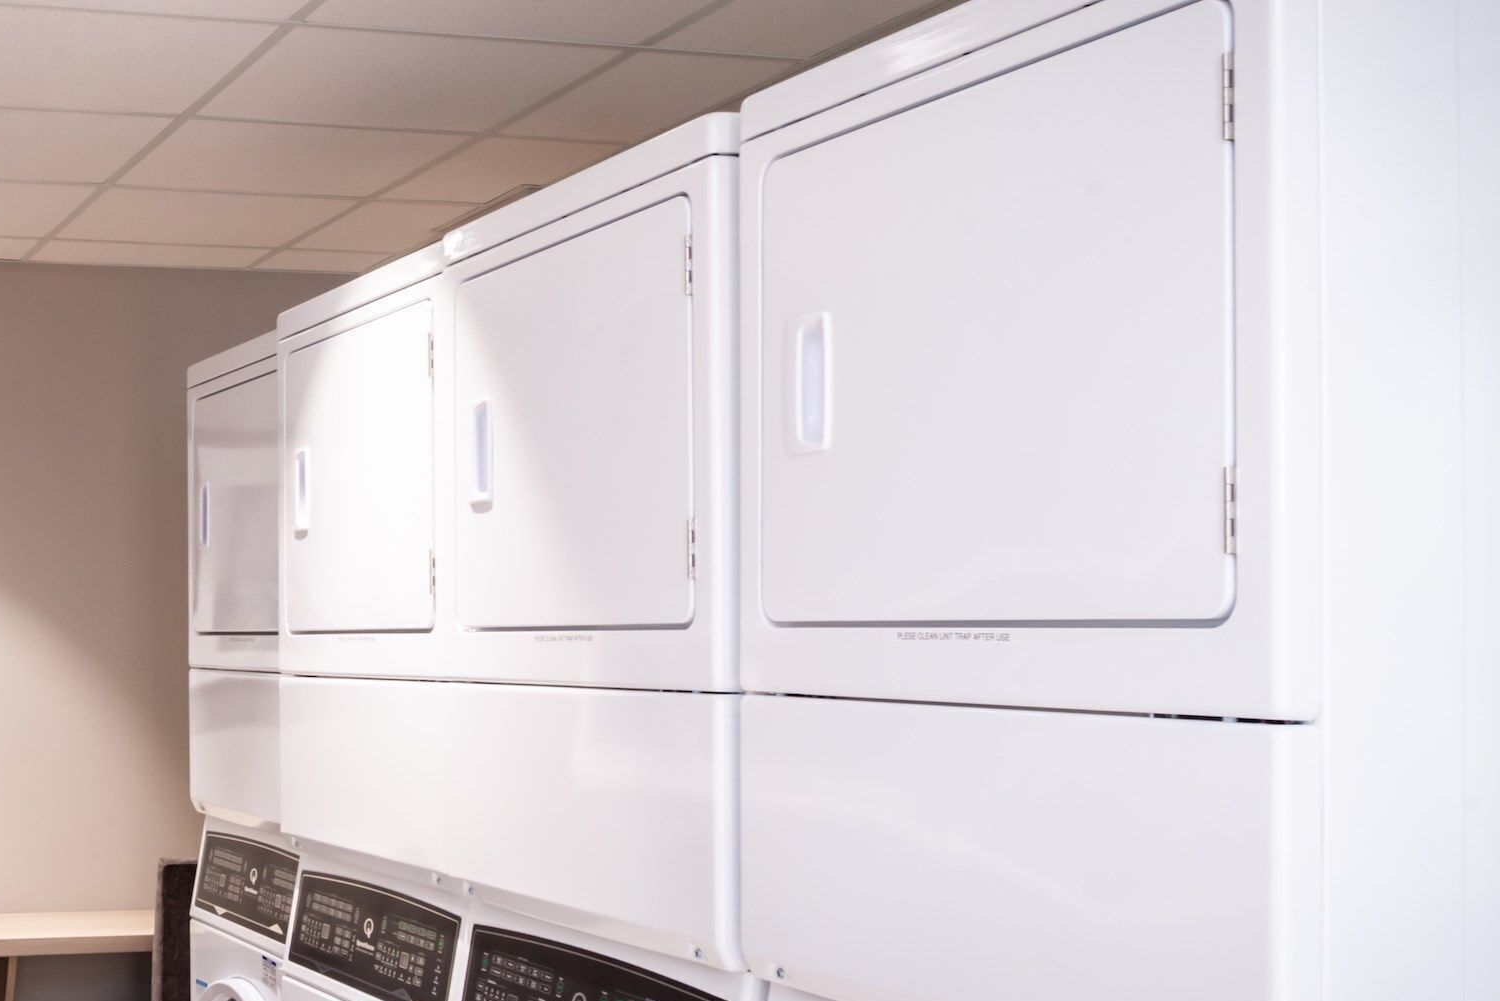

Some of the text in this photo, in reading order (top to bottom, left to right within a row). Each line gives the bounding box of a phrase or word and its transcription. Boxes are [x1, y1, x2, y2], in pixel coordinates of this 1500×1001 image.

[918, 632, 938, 640] CLEAN
[954, 632, 972, 640] TRAP
[973, 633, 994, 641] AFTER
[996, 633, 1010, 641] USE
